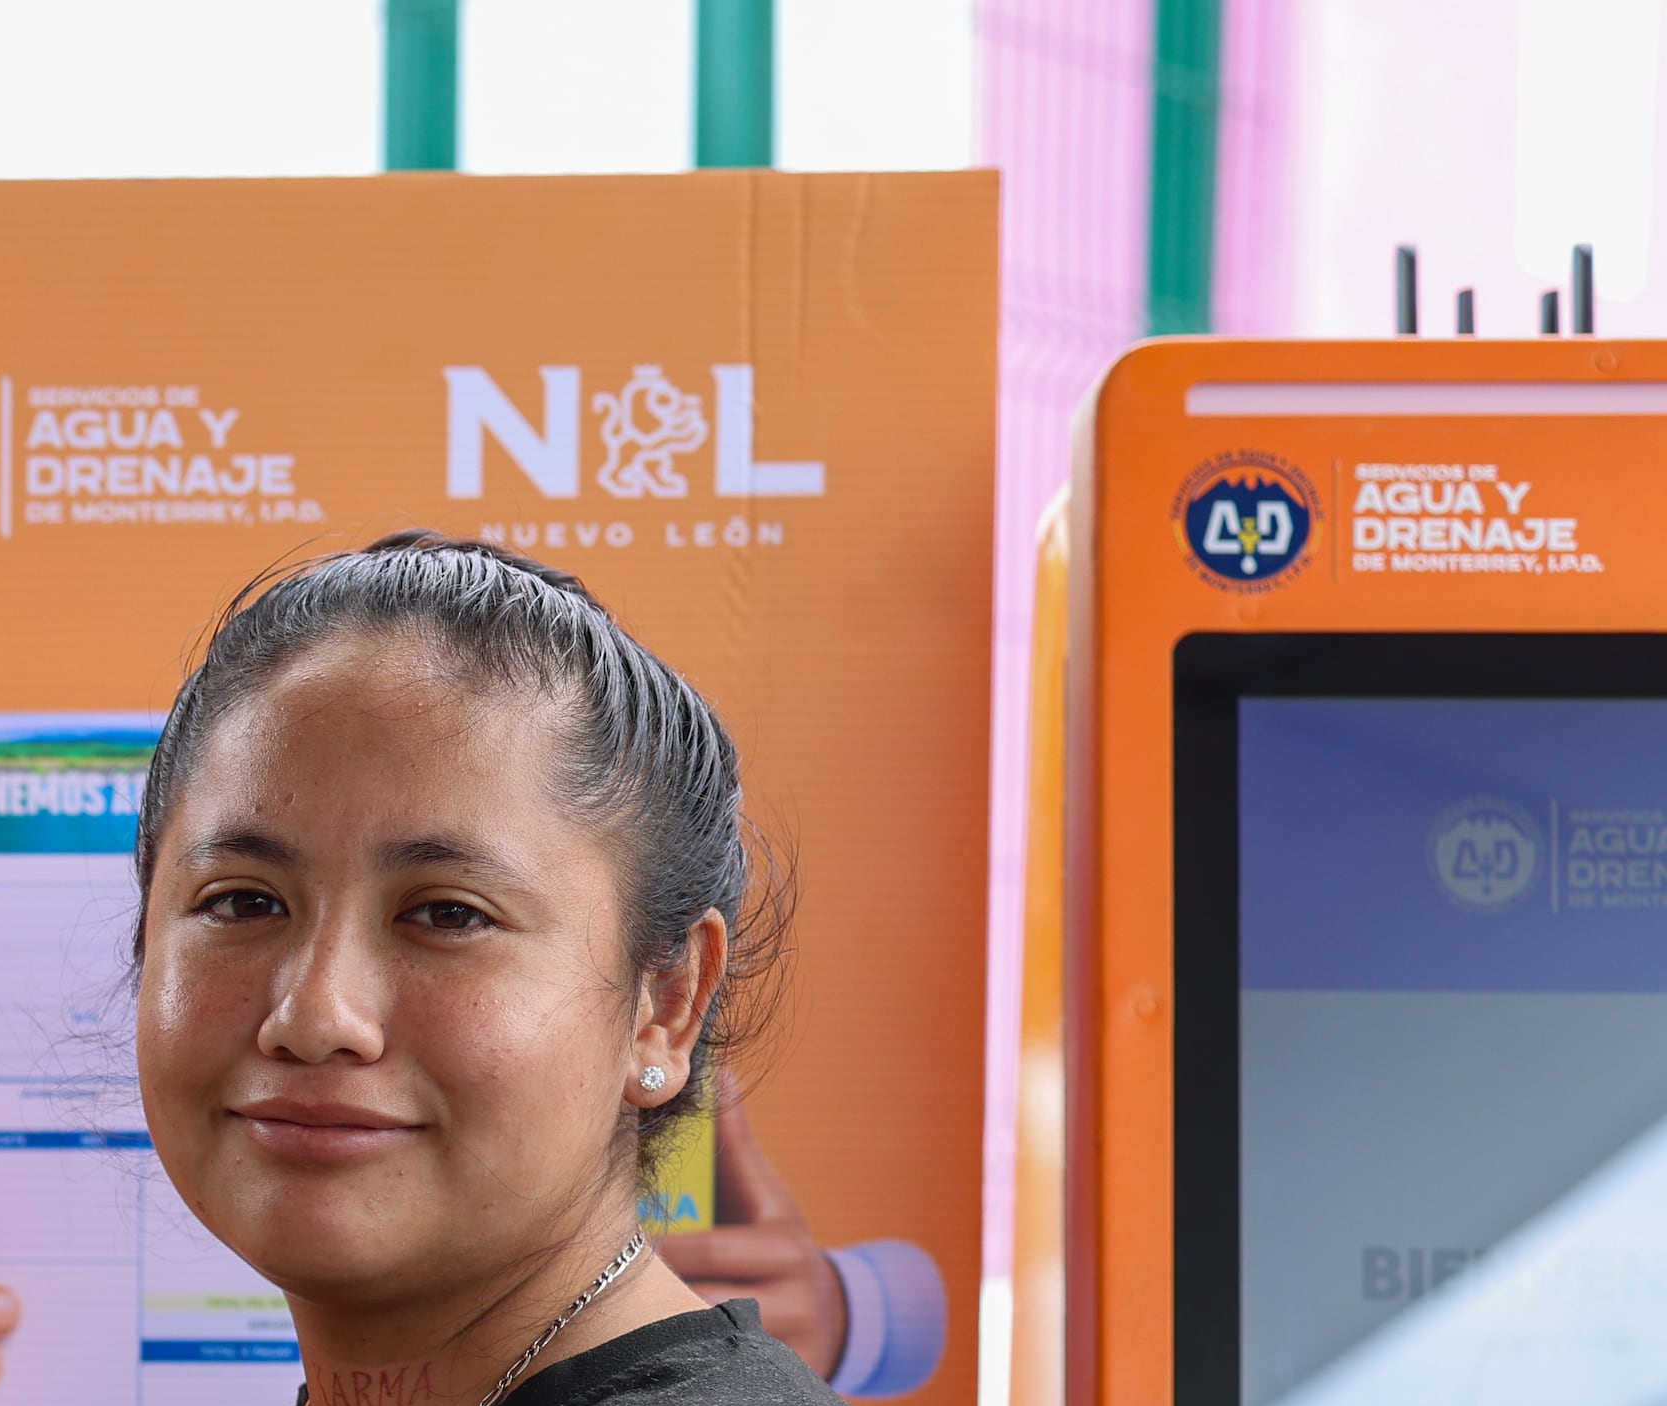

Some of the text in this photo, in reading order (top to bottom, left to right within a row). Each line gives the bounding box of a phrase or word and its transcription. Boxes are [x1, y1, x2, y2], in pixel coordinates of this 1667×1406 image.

[164, 386, 199, 406] DE
[26, 408, 239, 450] AGUA Y
[26, 455, 294, 496] DRENAJE
[1355, 464, 1498, 481] SERVICIOS DE
[26, 503, 63, 524] DE
[1354, 481, 1531, 514] AGUA Y
[480, 514, 784, 548] NUEVO LEÓN
[1353, 518, 1578, 551] DRENAJE
[1353, 554, 1384, 572] DE
